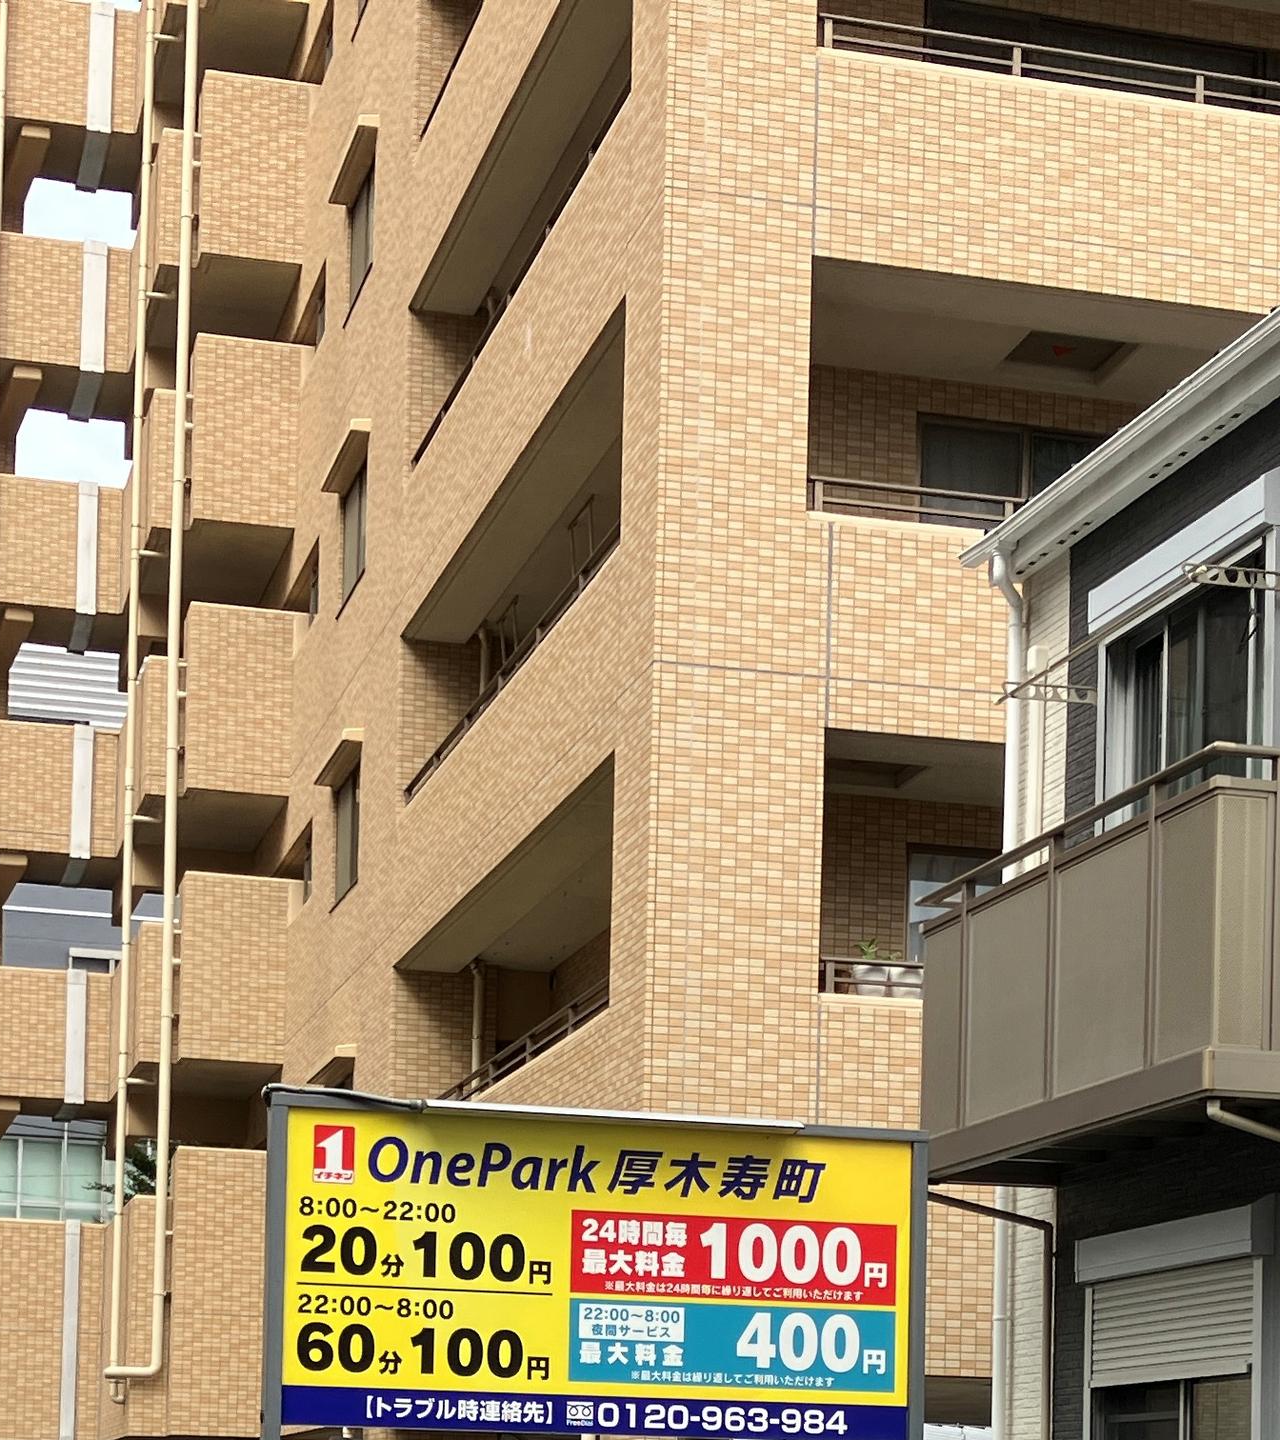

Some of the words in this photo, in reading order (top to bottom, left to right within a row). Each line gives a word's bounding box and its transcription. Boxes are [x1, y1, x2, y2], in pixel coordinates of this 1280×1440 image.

[581, 1219, 688, 1248] 24時間毎
[582, 1249, 686, 1278] 最大料金
[700, 1223, 888, 1288] 1000円
[591, 1323, 671, 1338] 夜間サービス
[736, 1312, 886, 1374] 400円
[579, 1341, 684, 1368] 最大料金
[598, 1402, 848, 1435] 0120-963-984
